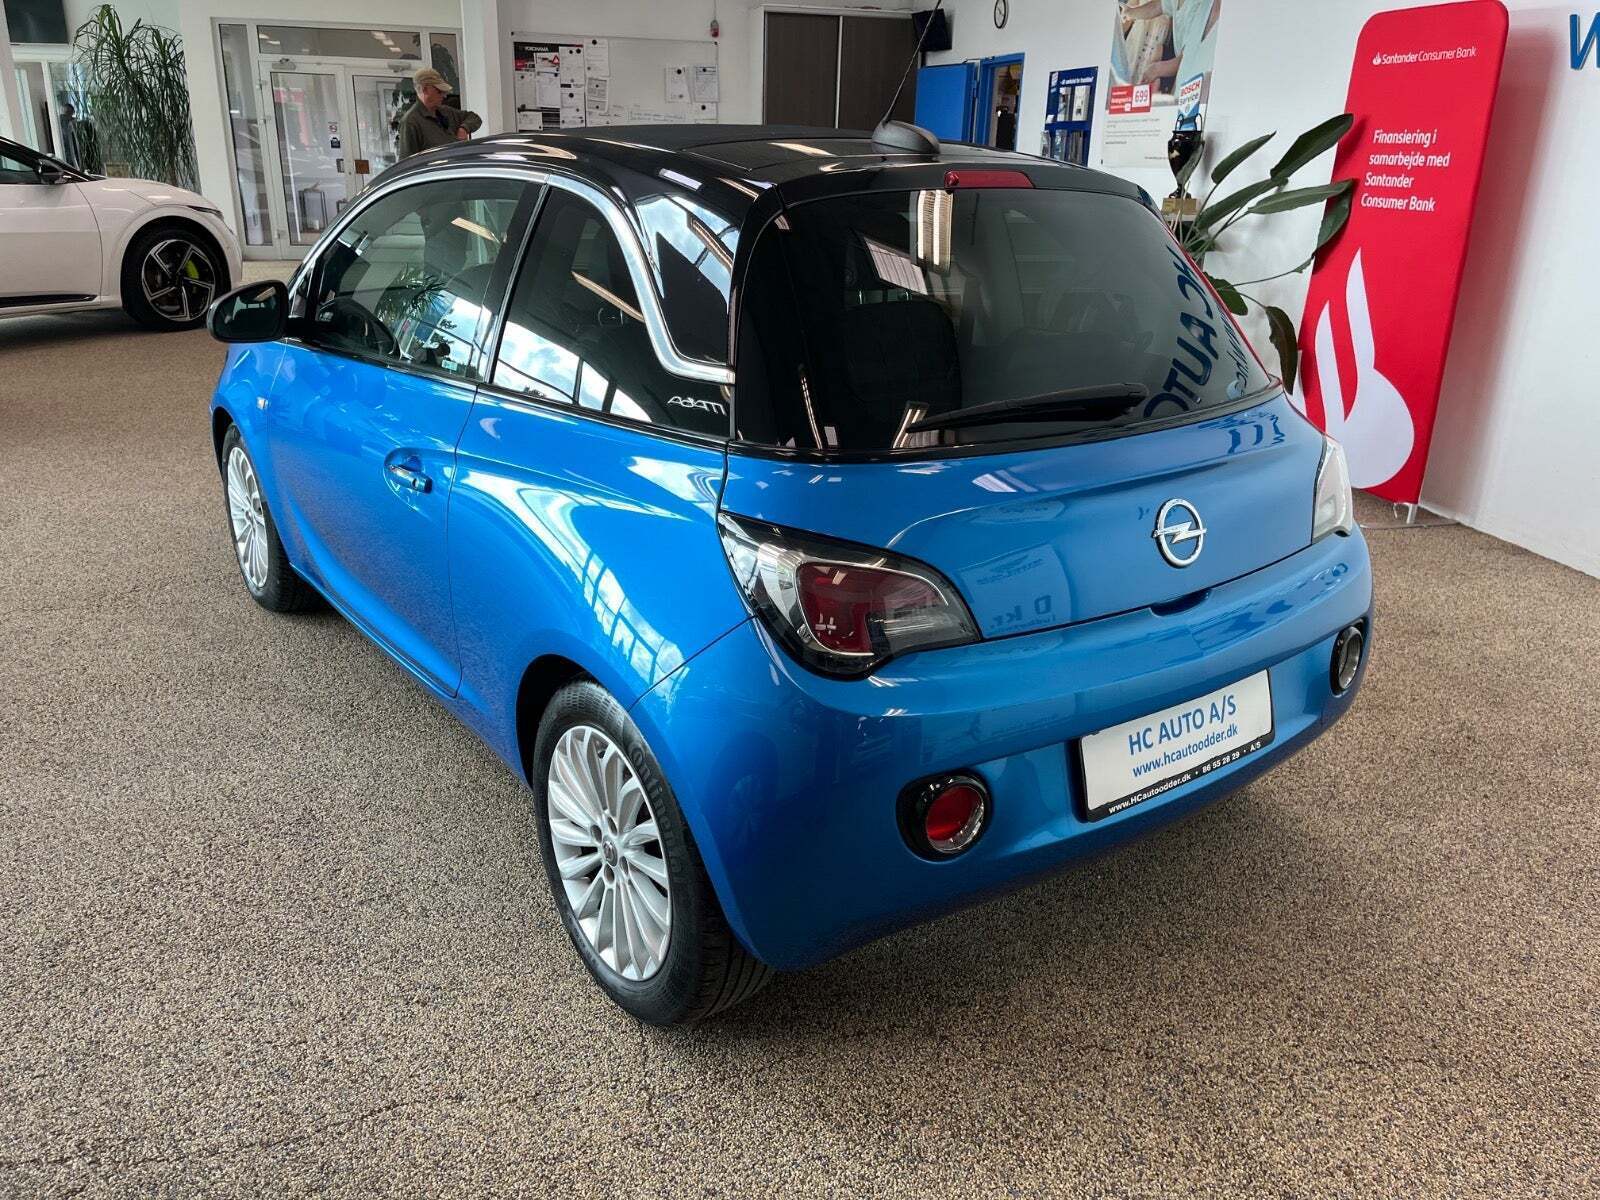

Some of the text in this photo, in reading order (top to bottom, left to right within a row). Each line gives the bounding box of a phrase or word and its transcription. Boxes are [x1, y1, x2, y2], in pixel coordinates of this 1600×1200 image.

[1382, 46, 1477, 65] Santander Consumer Bank
[1135, 89, 1148, 103] 699
[1180, 80, 1201, 97] BOSCH
[1373, 128, 1437, 148] Finansiering i
[1368, 151, 1450, 170] samarbejde med
[1365, 173, 1415, 189] Santander
[1361, 193, 1437, 212] Consumer Bank
[1128, 694, 1237, 756] HC AUTO A/S
[1132, 723, 1239, 778] www.hcautoodder.dk
[1108, 773, 1192, 814] www.HCautoodder.dk
